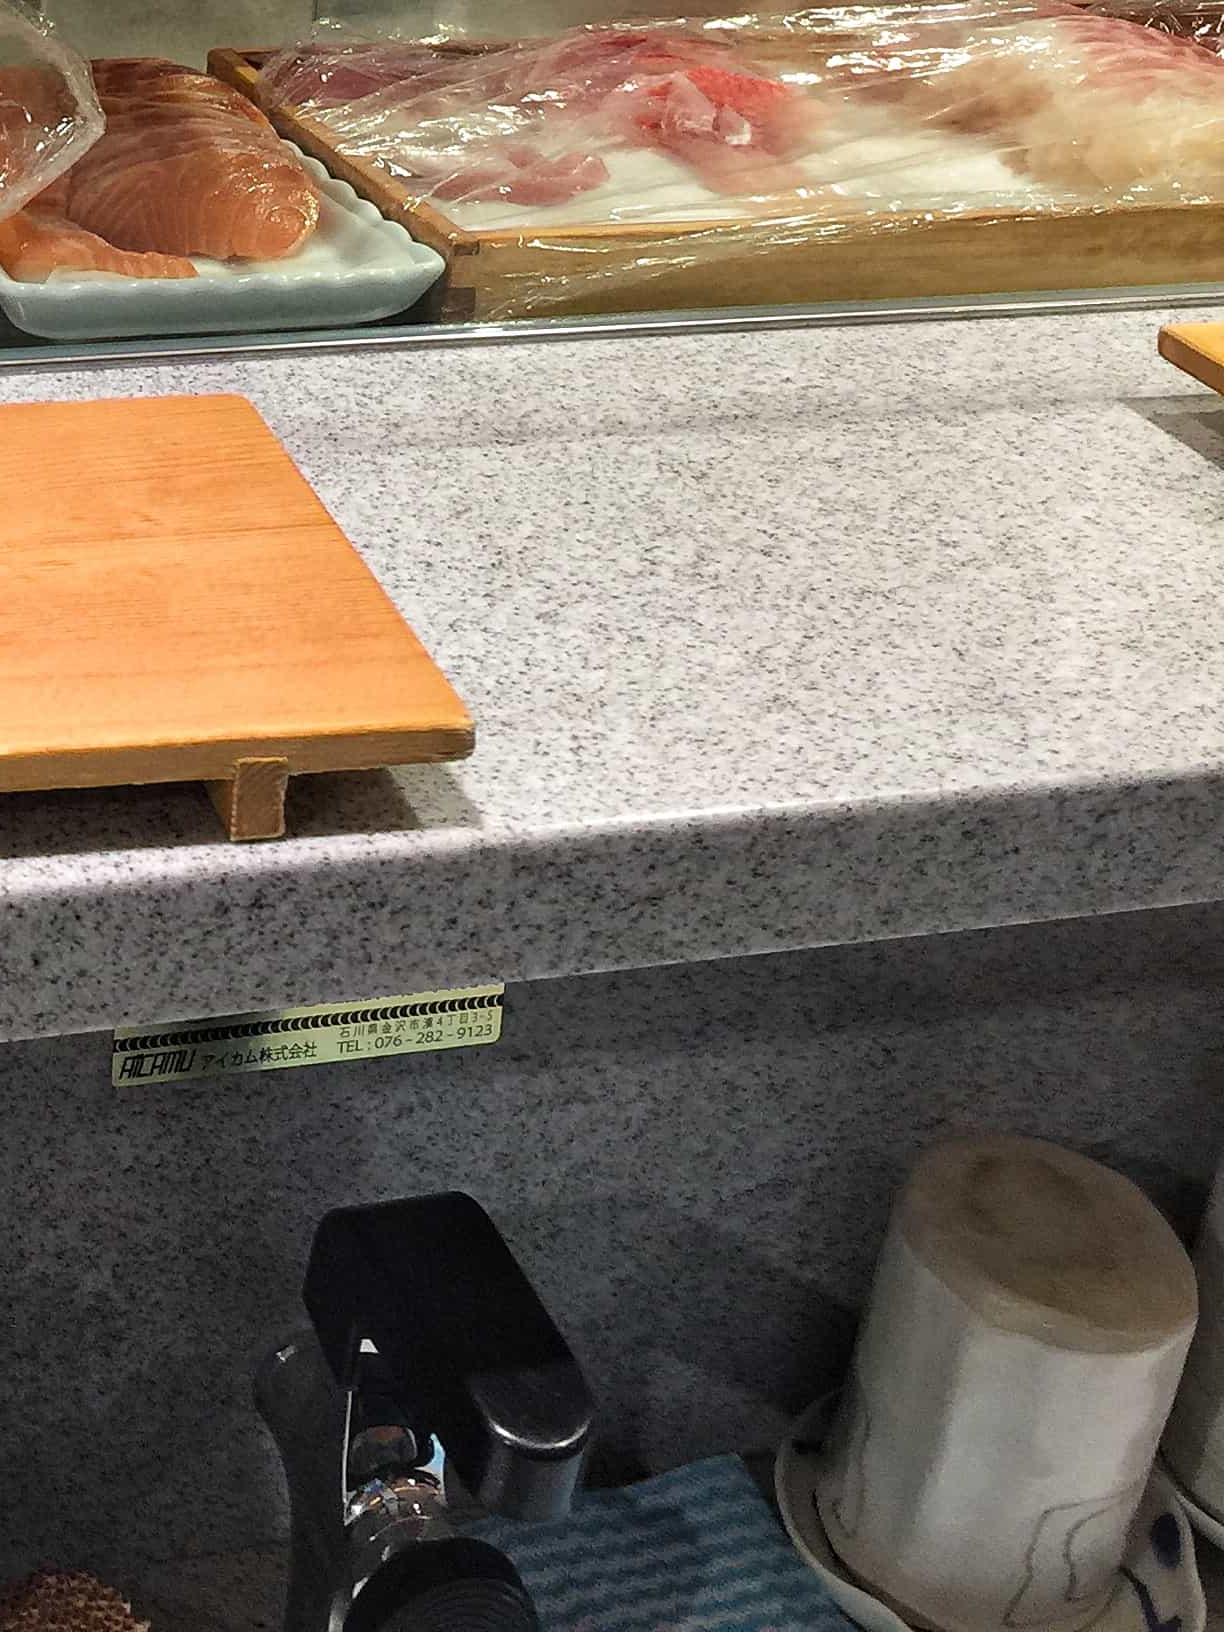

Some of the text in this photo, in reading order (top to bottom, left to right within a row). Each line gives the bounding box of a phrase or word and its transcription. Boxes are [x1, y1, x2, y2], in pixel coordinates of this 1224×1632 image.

[201, 1040, 318, 1071] アイカム株式会社
